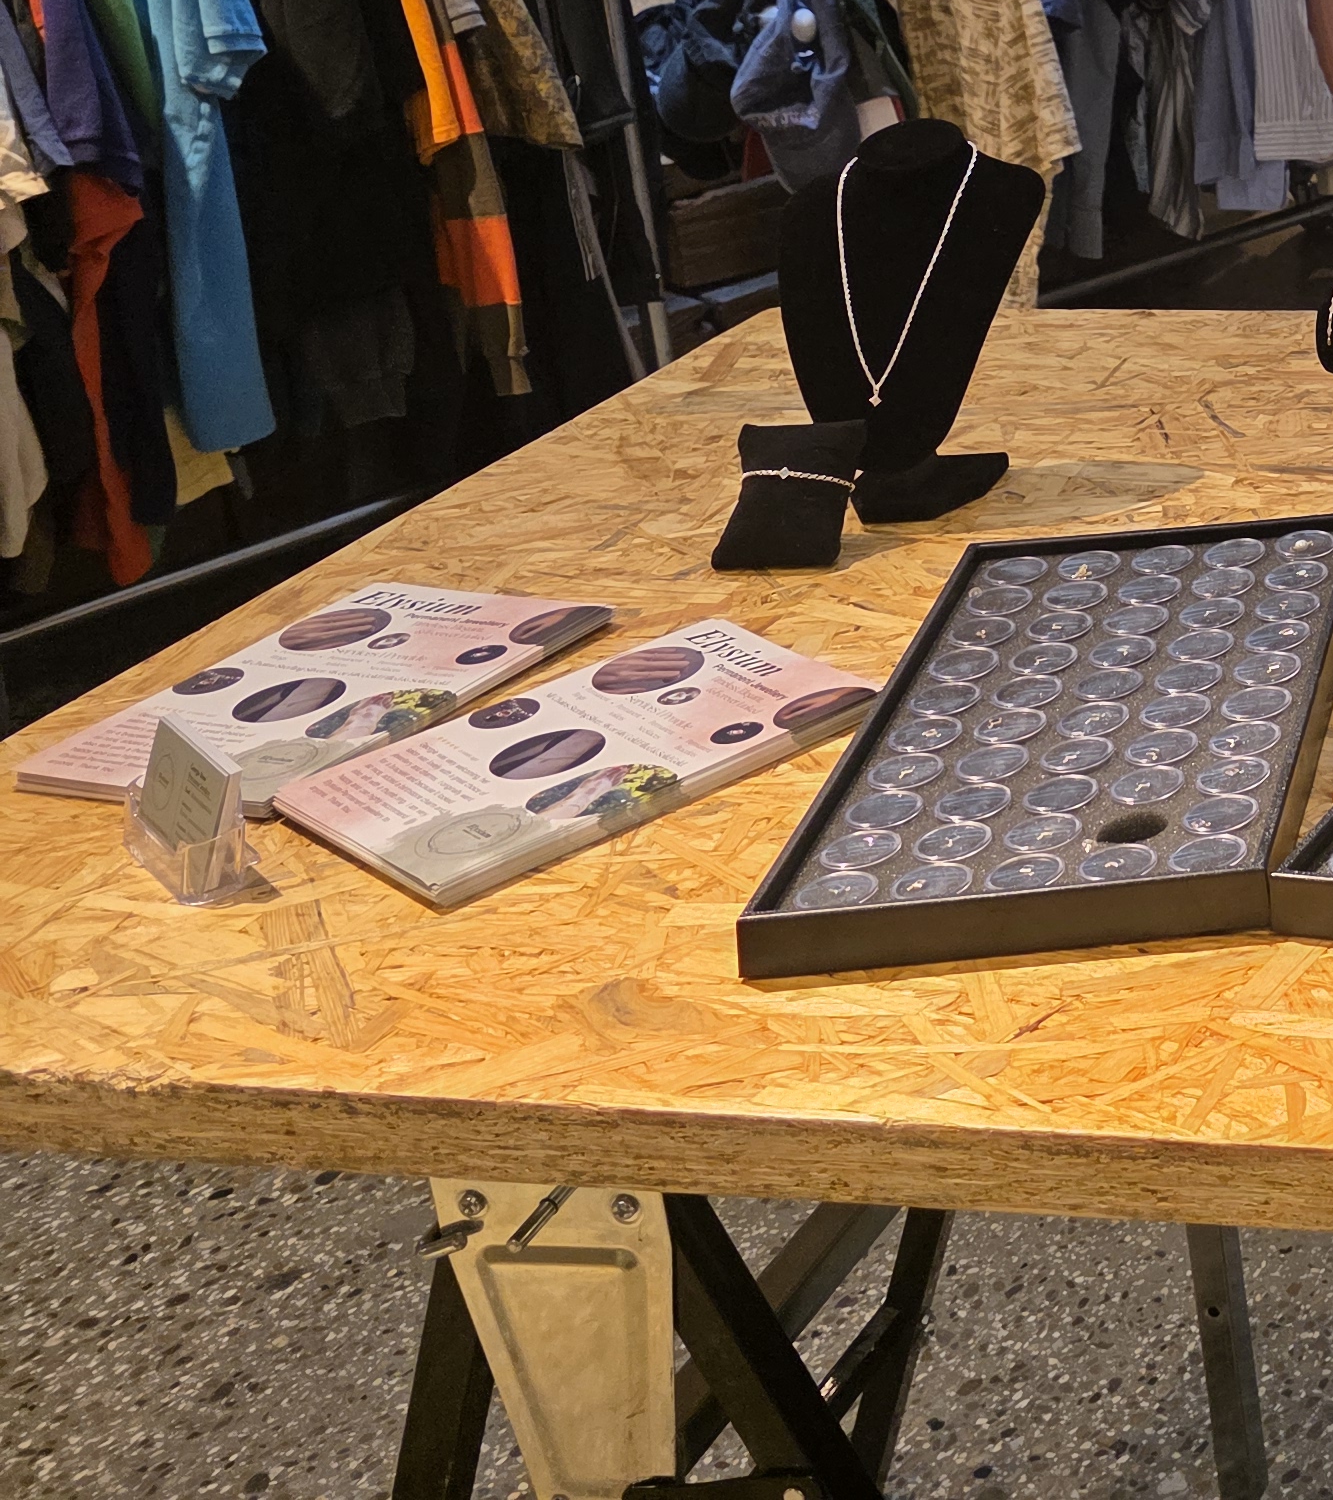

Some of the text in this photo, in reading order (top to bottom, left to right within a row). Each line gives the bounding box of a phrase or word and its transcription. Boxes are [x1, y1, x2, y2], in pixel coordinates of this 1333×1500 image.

[352, 591, 483, 616] Elysium
[403, 611, 461, 626] Permanent
[684, 629, 784, 678] Elysium
